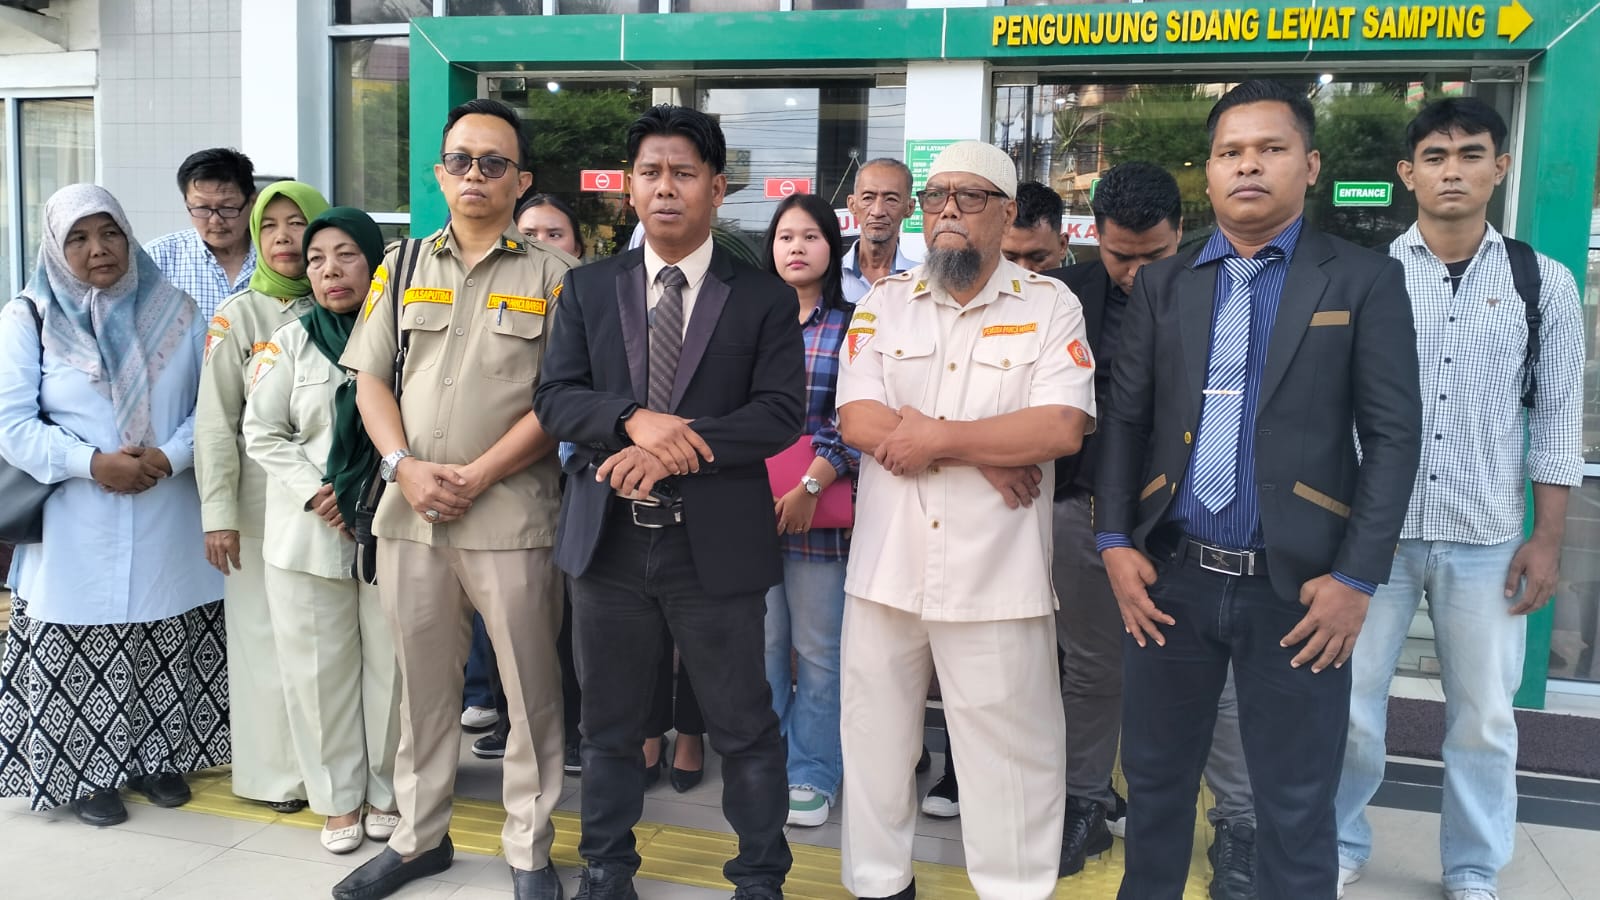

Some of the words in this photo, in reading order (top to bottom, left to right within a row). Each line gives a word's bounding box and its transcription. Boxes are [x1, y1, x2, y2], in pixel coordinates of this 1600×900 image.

[992, 10, 1158, 46] PENGUNJUNG
[1165, 8, 1259, 42] SIDANG
[1267, 7, 1356, 40] LEWAT
[1362, 5, 1486, 39] SAMPING
[1339, 188, 1386, 198] ENTRANCE
[1061, 223, 1098, 239] KA
